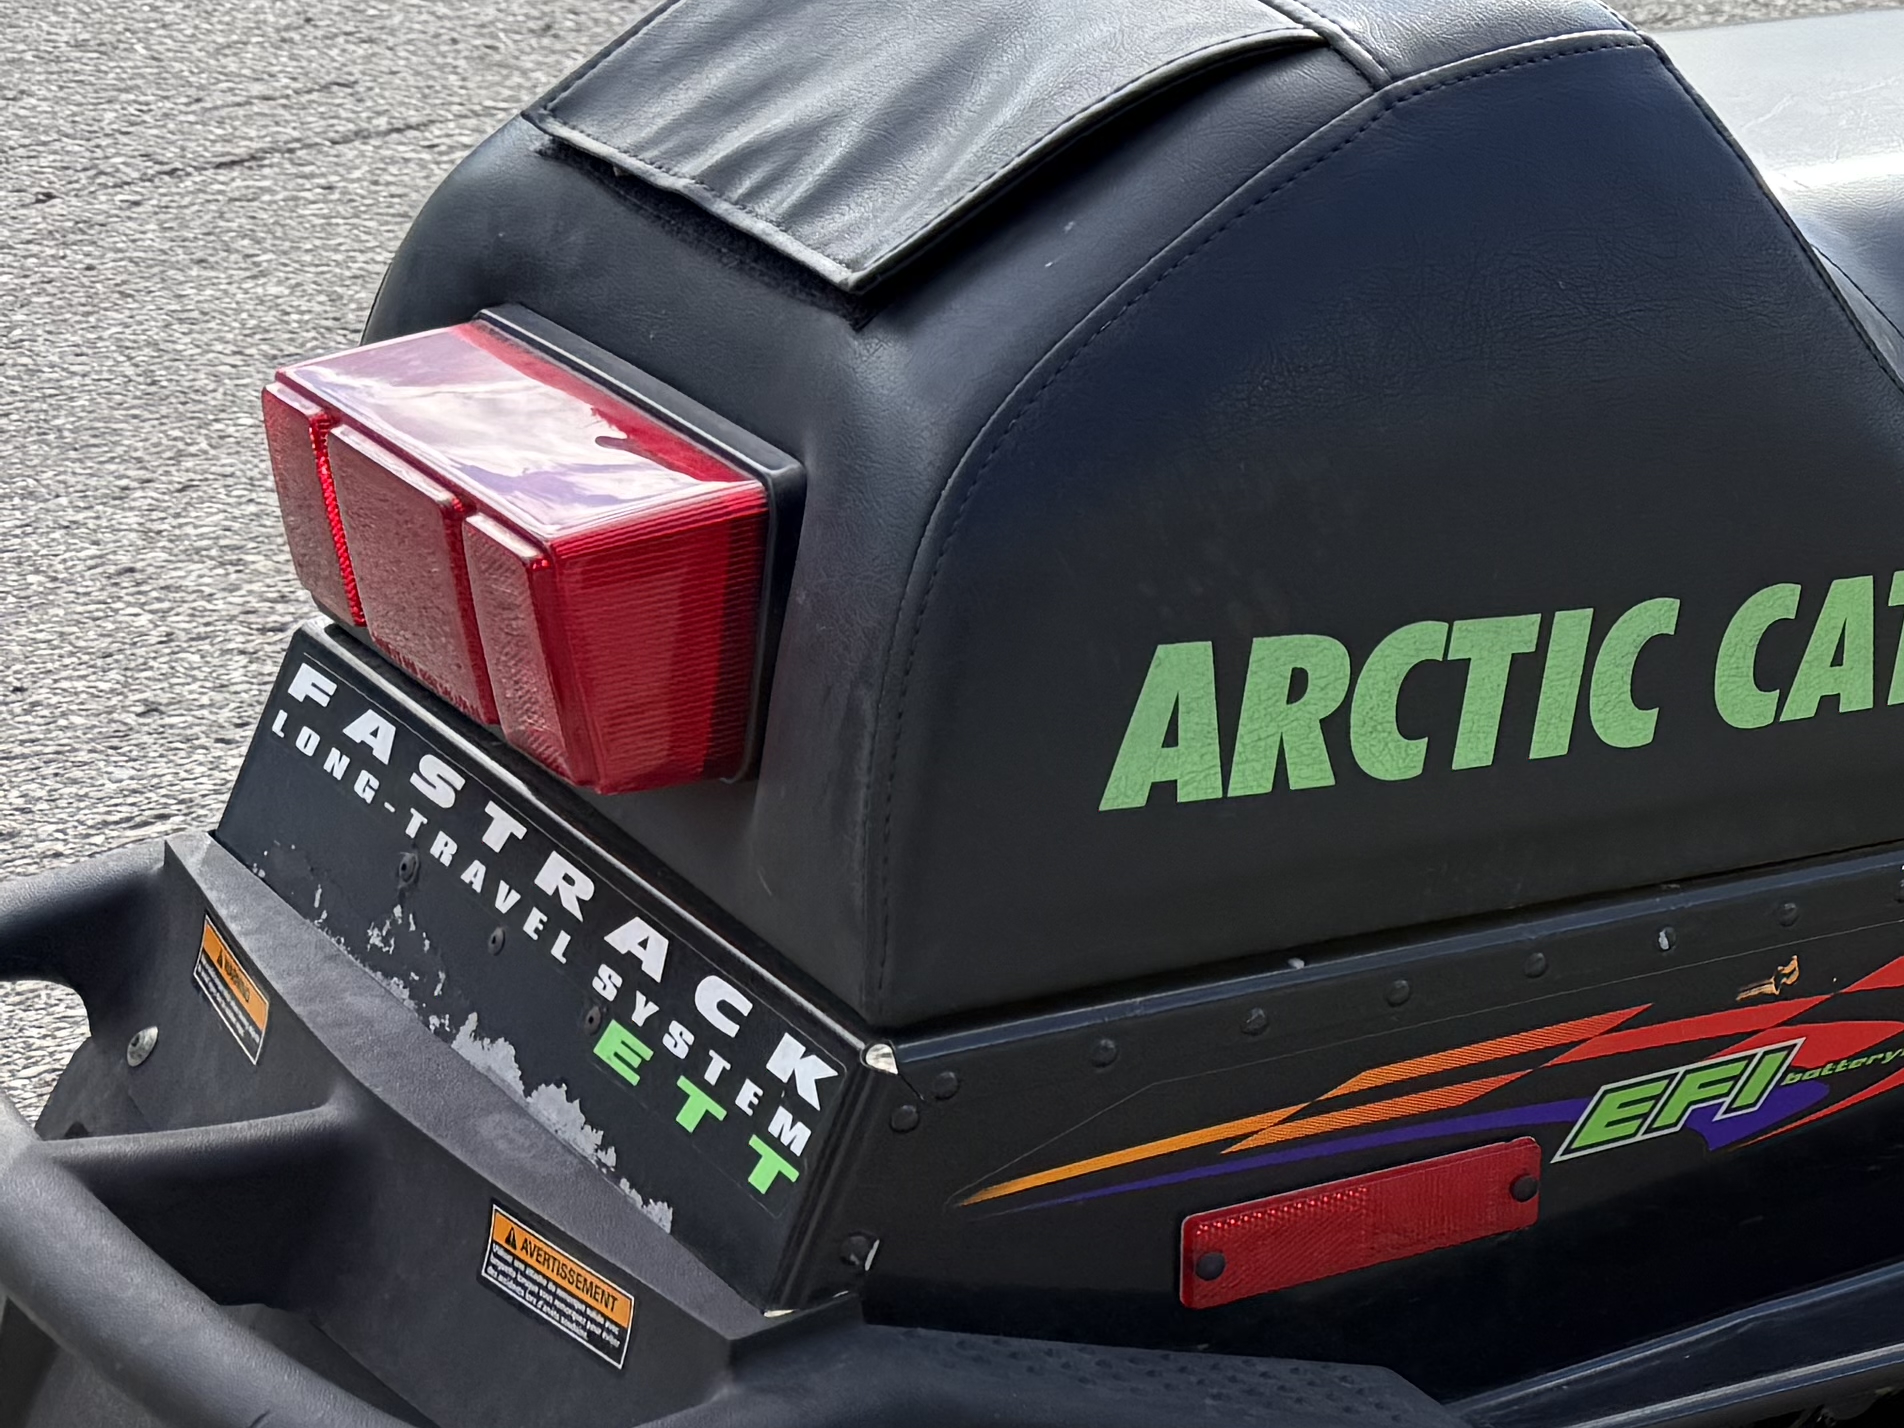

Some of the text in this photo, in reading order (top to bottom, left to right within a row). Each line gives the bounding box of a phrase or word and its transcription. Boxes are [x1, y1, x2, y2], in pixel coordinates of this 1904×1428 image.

[1098, 597, 1681, 812] ARCTIC
[271, 708, 812, 1157] LONG-TRAVEL SYSTEM
[287, 662, 838, 1111] FASTRACK
[592, 1018, 800, 1195] ETT
[1554, 1039, 1804, 1161] EFI
[519, 1236, 619, 1313] AVERTISSEMENT
